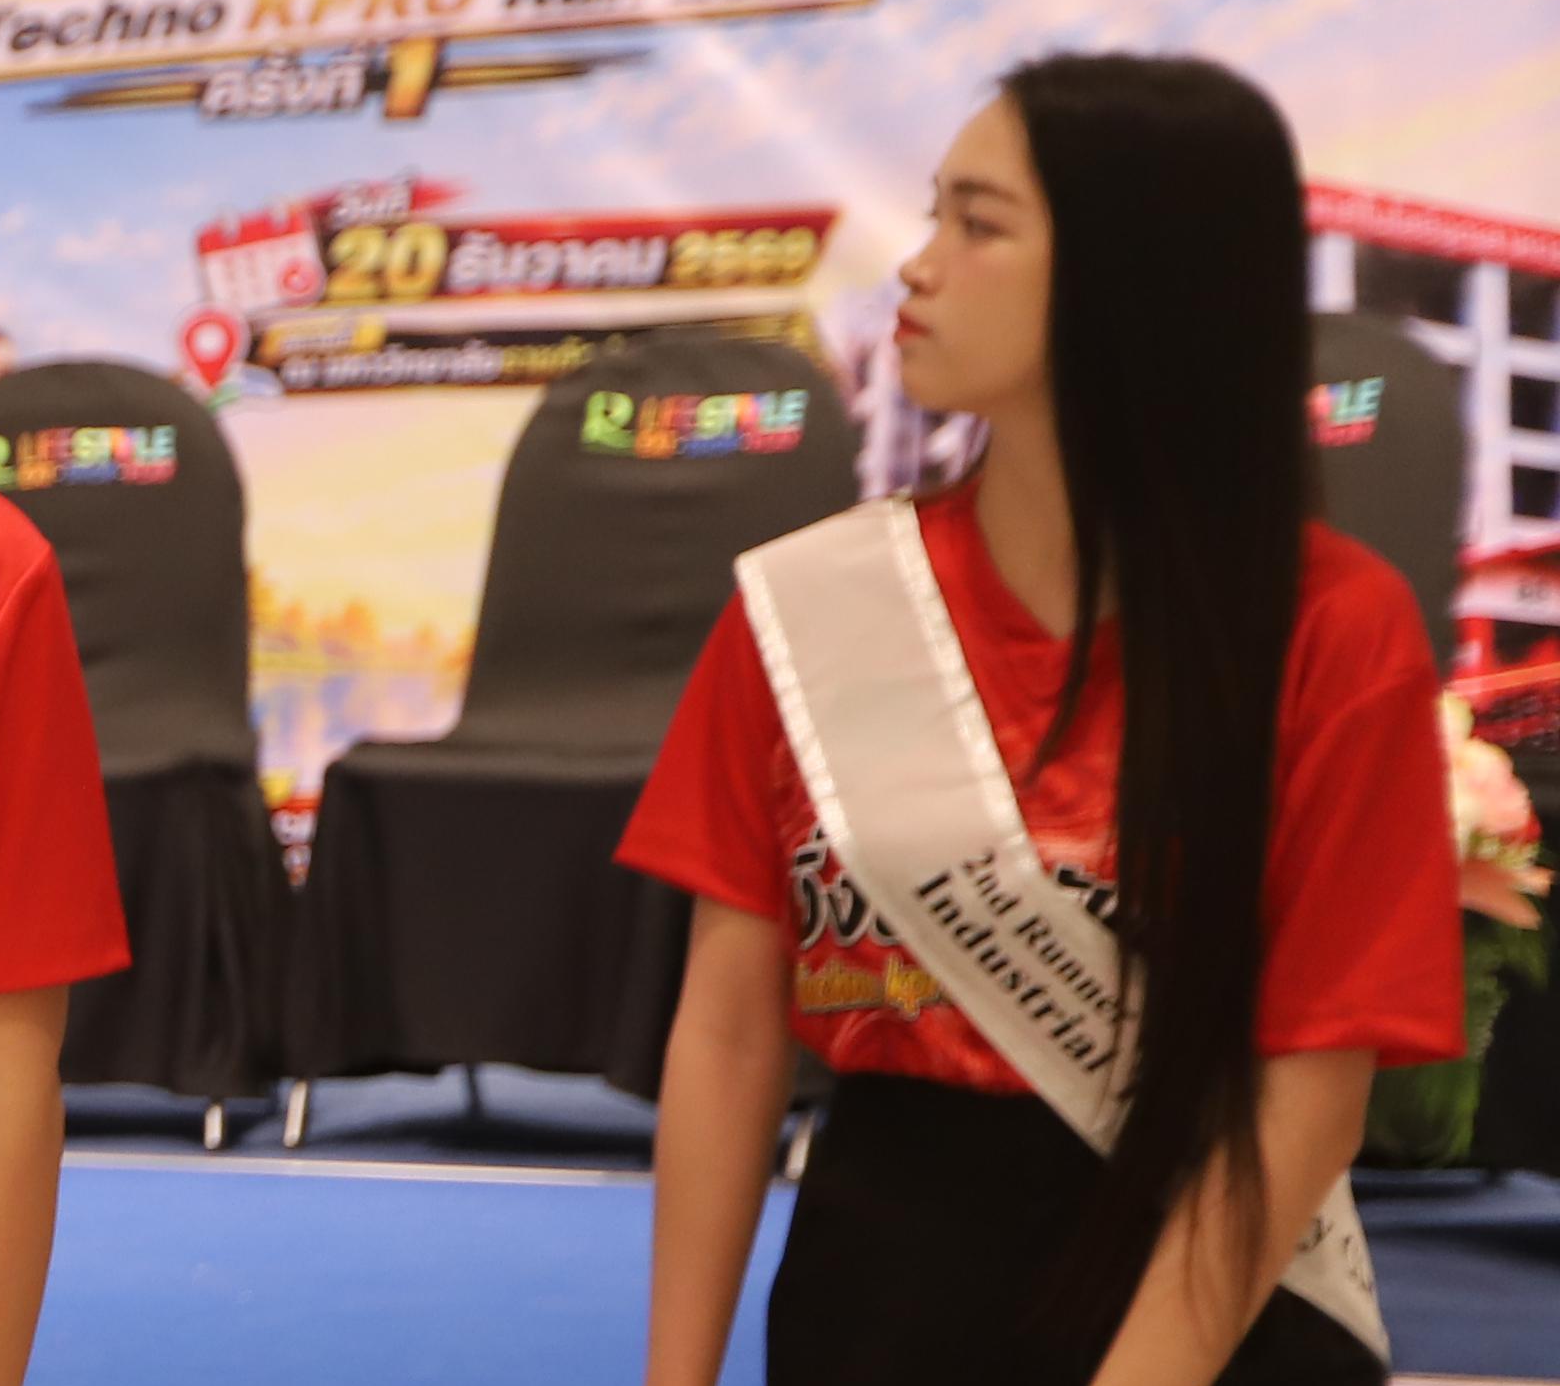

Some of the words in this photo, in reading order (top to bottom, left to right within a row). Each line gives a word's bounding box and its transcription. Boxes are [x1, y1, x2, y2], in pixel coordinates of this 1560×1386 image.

[325, 222, 447, 300] 20
[915, 871, 1115, 1072] Industrial
[961, 848, 1018, 915] 2nd
[1017, 913, 1122, 1023] Runne
